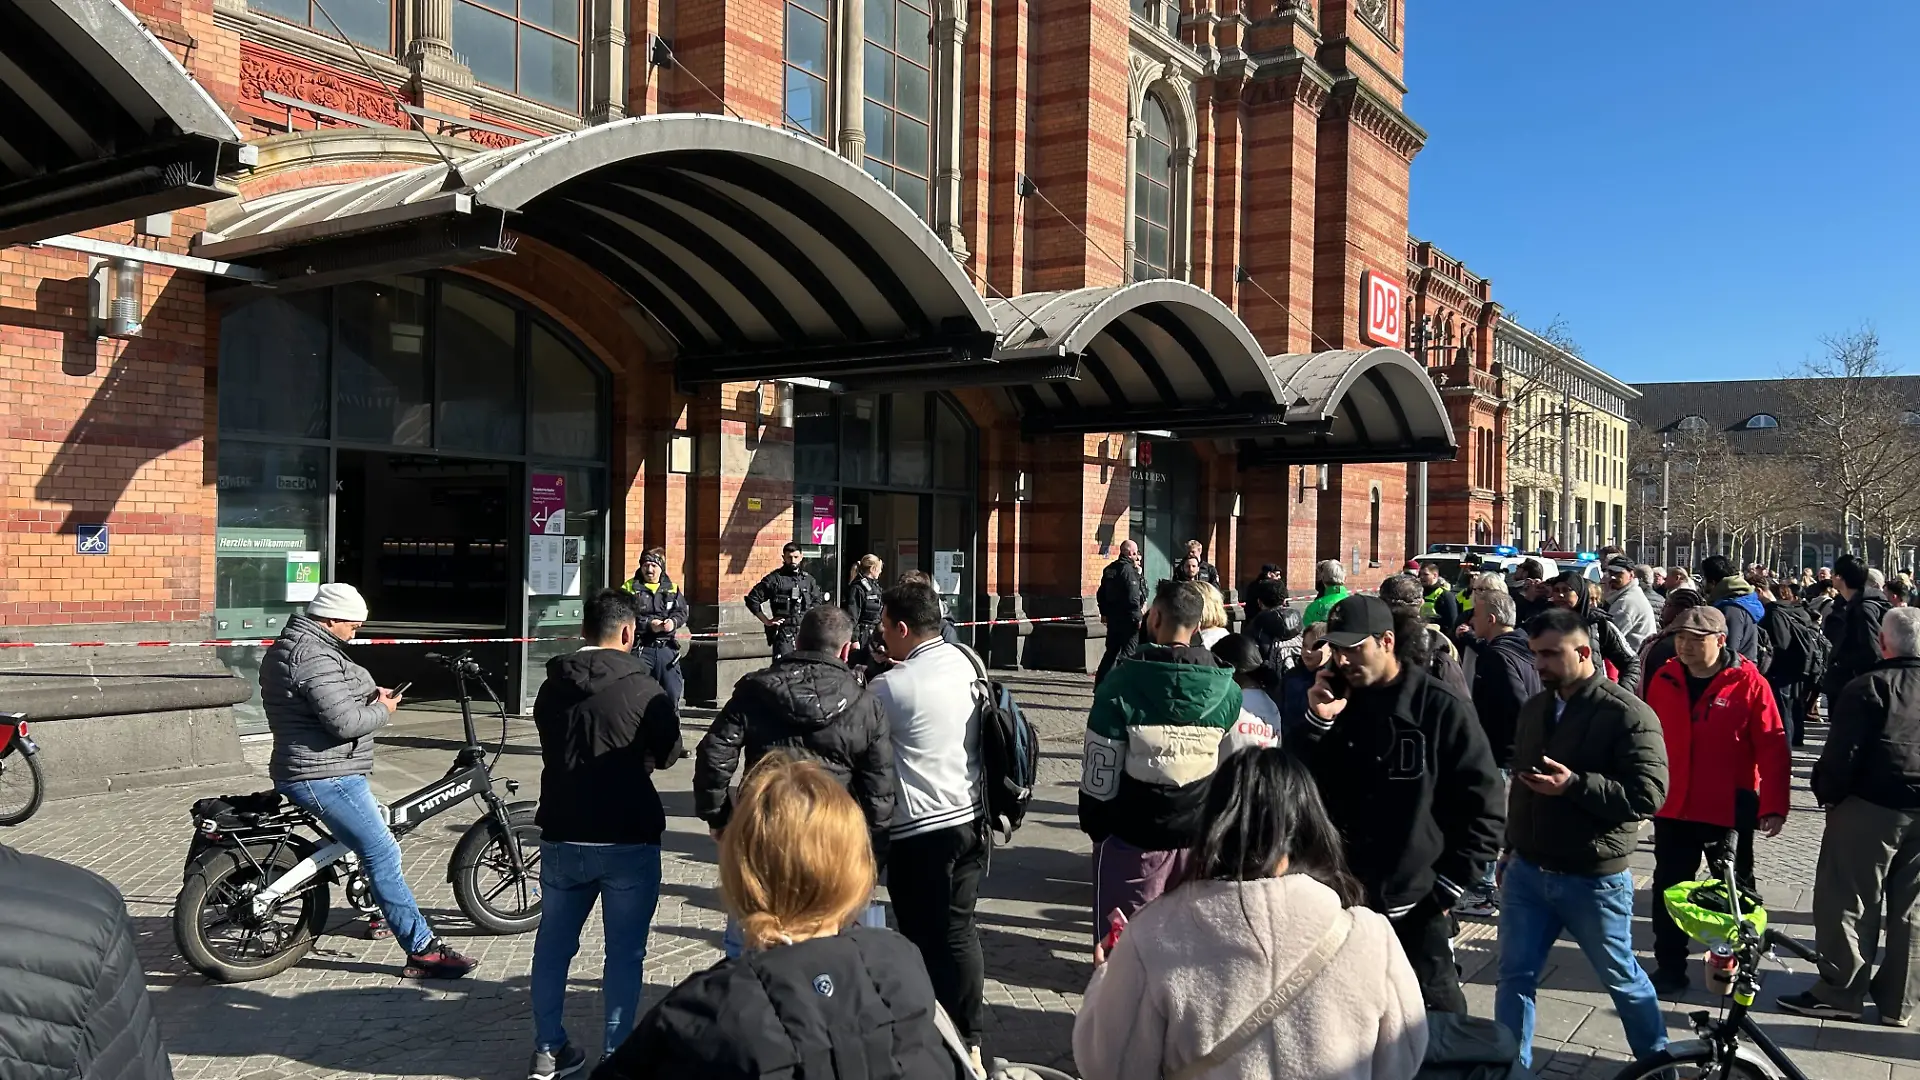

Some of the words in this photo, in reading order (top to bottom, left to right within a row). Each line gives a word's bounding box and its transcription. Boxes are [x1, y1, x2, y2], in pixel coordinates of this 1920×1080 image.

[1373, 282, 1397, 335] DB
[220, 538, 252, 548] Herzlich
[1084, 741, 1116, 796] G
[1388, 729, 1426, 780] D
[418, 779, 473, 813] HITWAY
